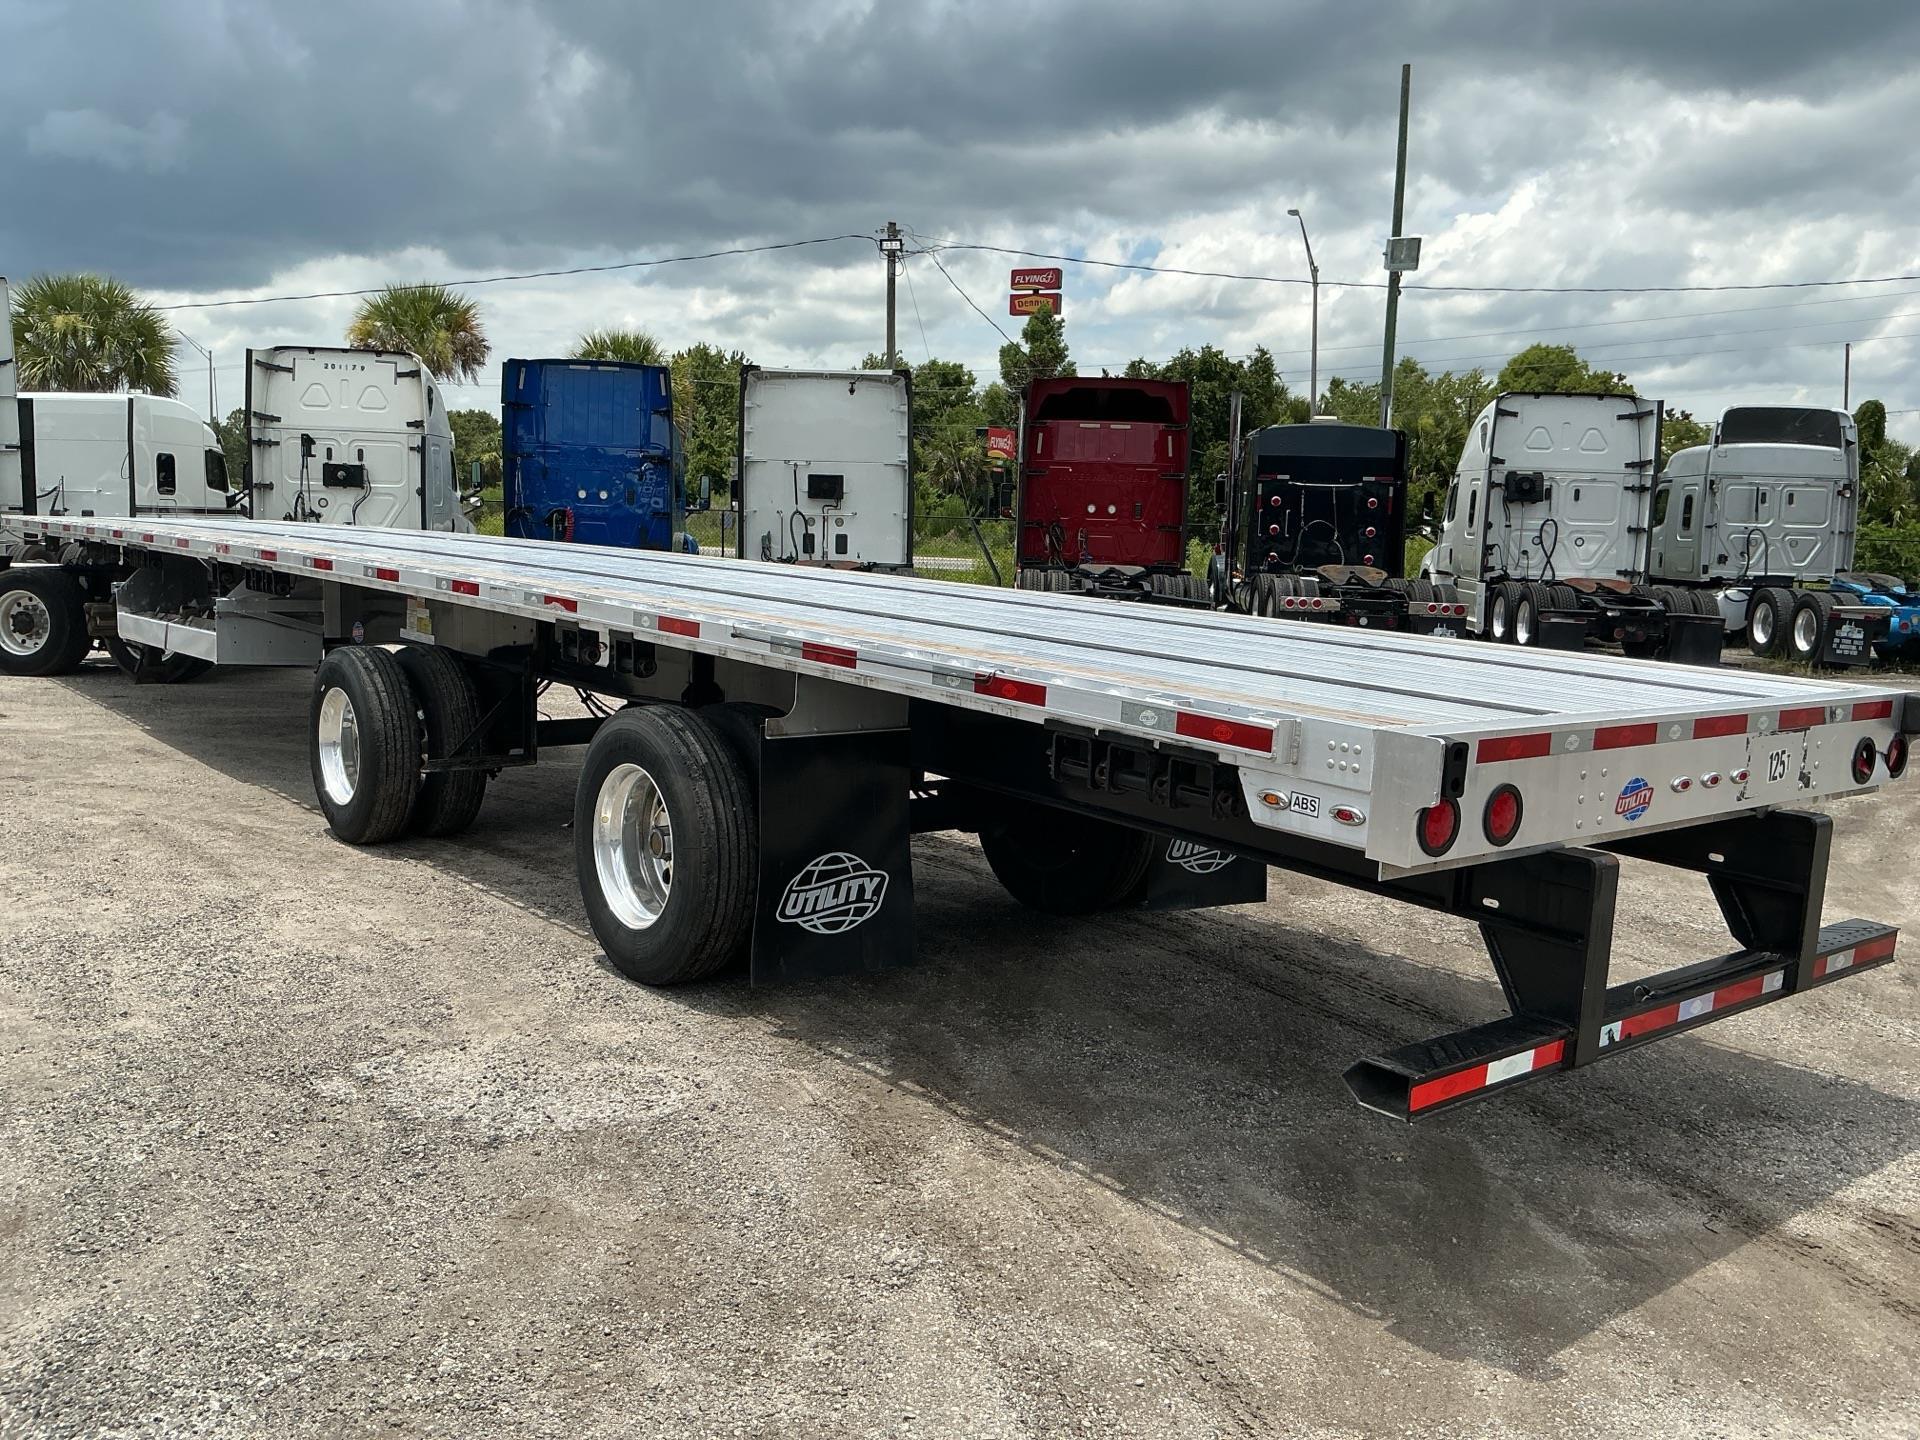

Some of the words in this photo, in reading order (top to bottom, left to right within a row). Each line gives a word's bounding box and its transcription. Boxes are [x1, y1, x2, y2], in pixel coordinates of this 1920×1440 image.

[1015, 274, 1046, 283] FLYING
[1292, 795, 1317, 812] ABS
[1616, 789, 1652, 813] UTILITY
[785, 877, 881, 916] UTILITY
